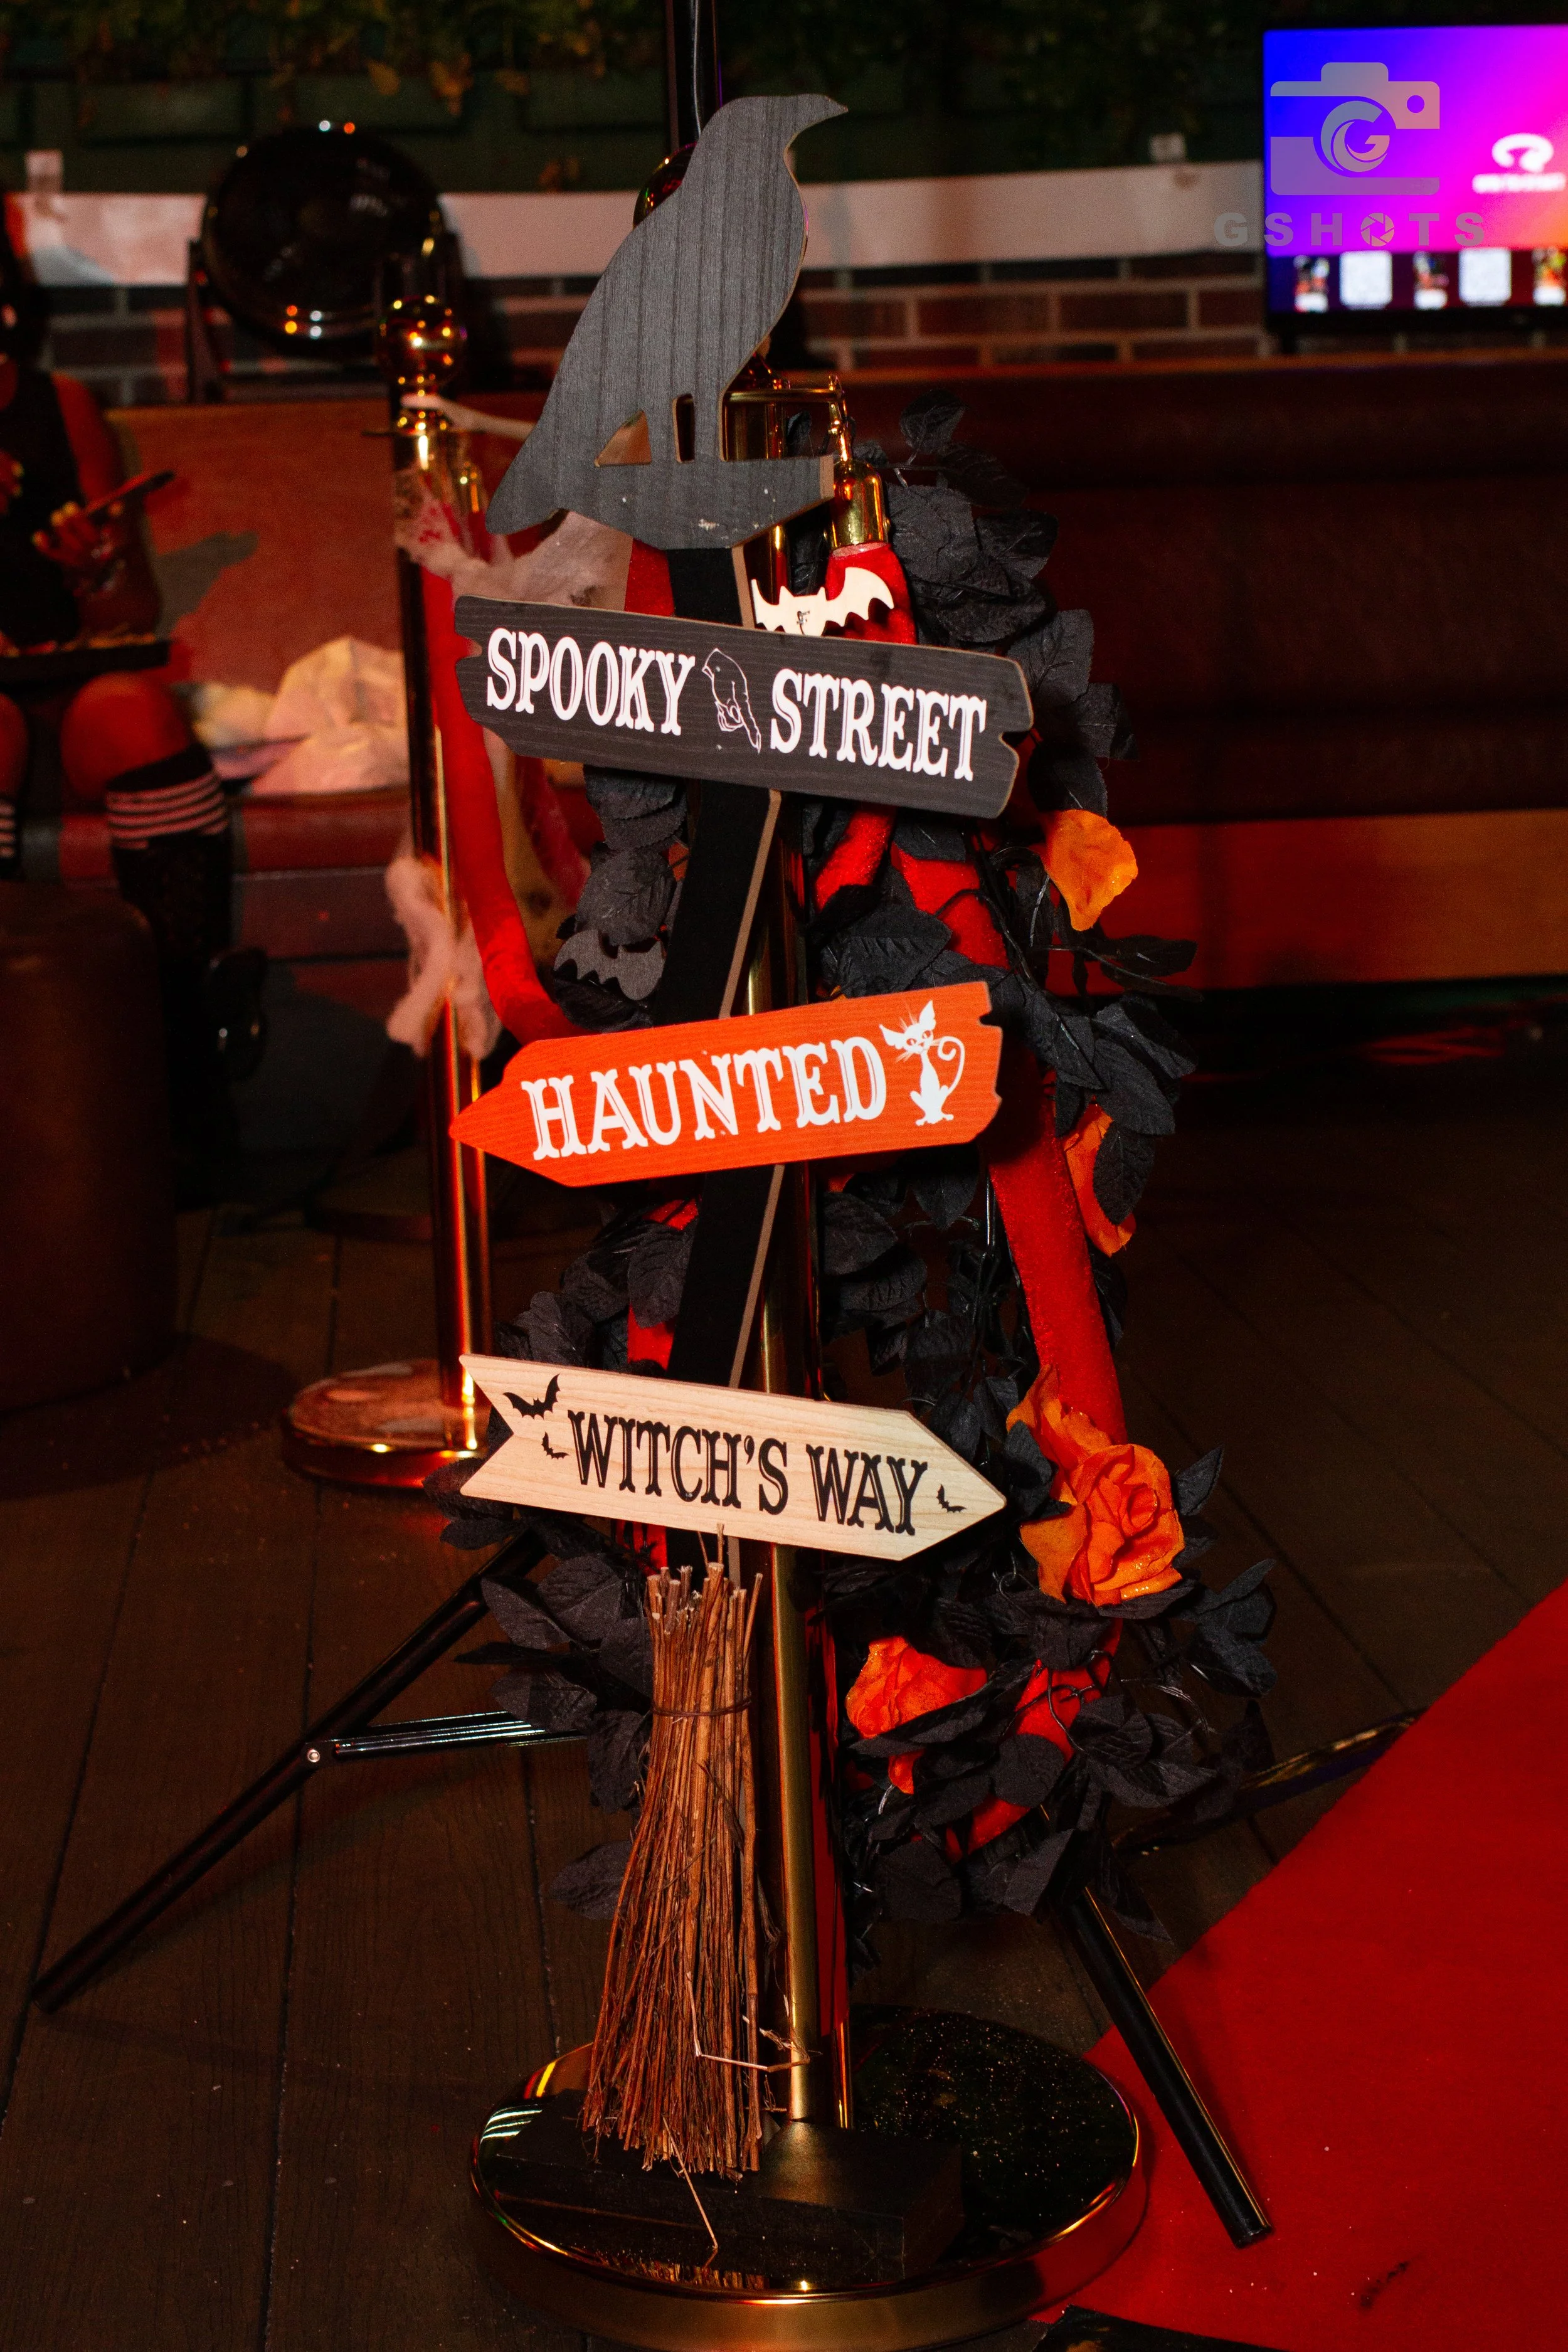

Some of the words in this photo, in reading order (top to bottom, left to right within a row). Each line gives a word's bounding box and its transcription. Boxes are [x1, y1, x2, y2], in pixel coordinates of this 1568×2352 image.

[487, 628, 696, 735] SPOOKY
[770, 668, 986, 781] STREET
[521, 1037, 886, 1160] HAUNTED
[568, 1410, 788, 1515] WITCH'S
[806, 1444, 928, 1535] WAY
